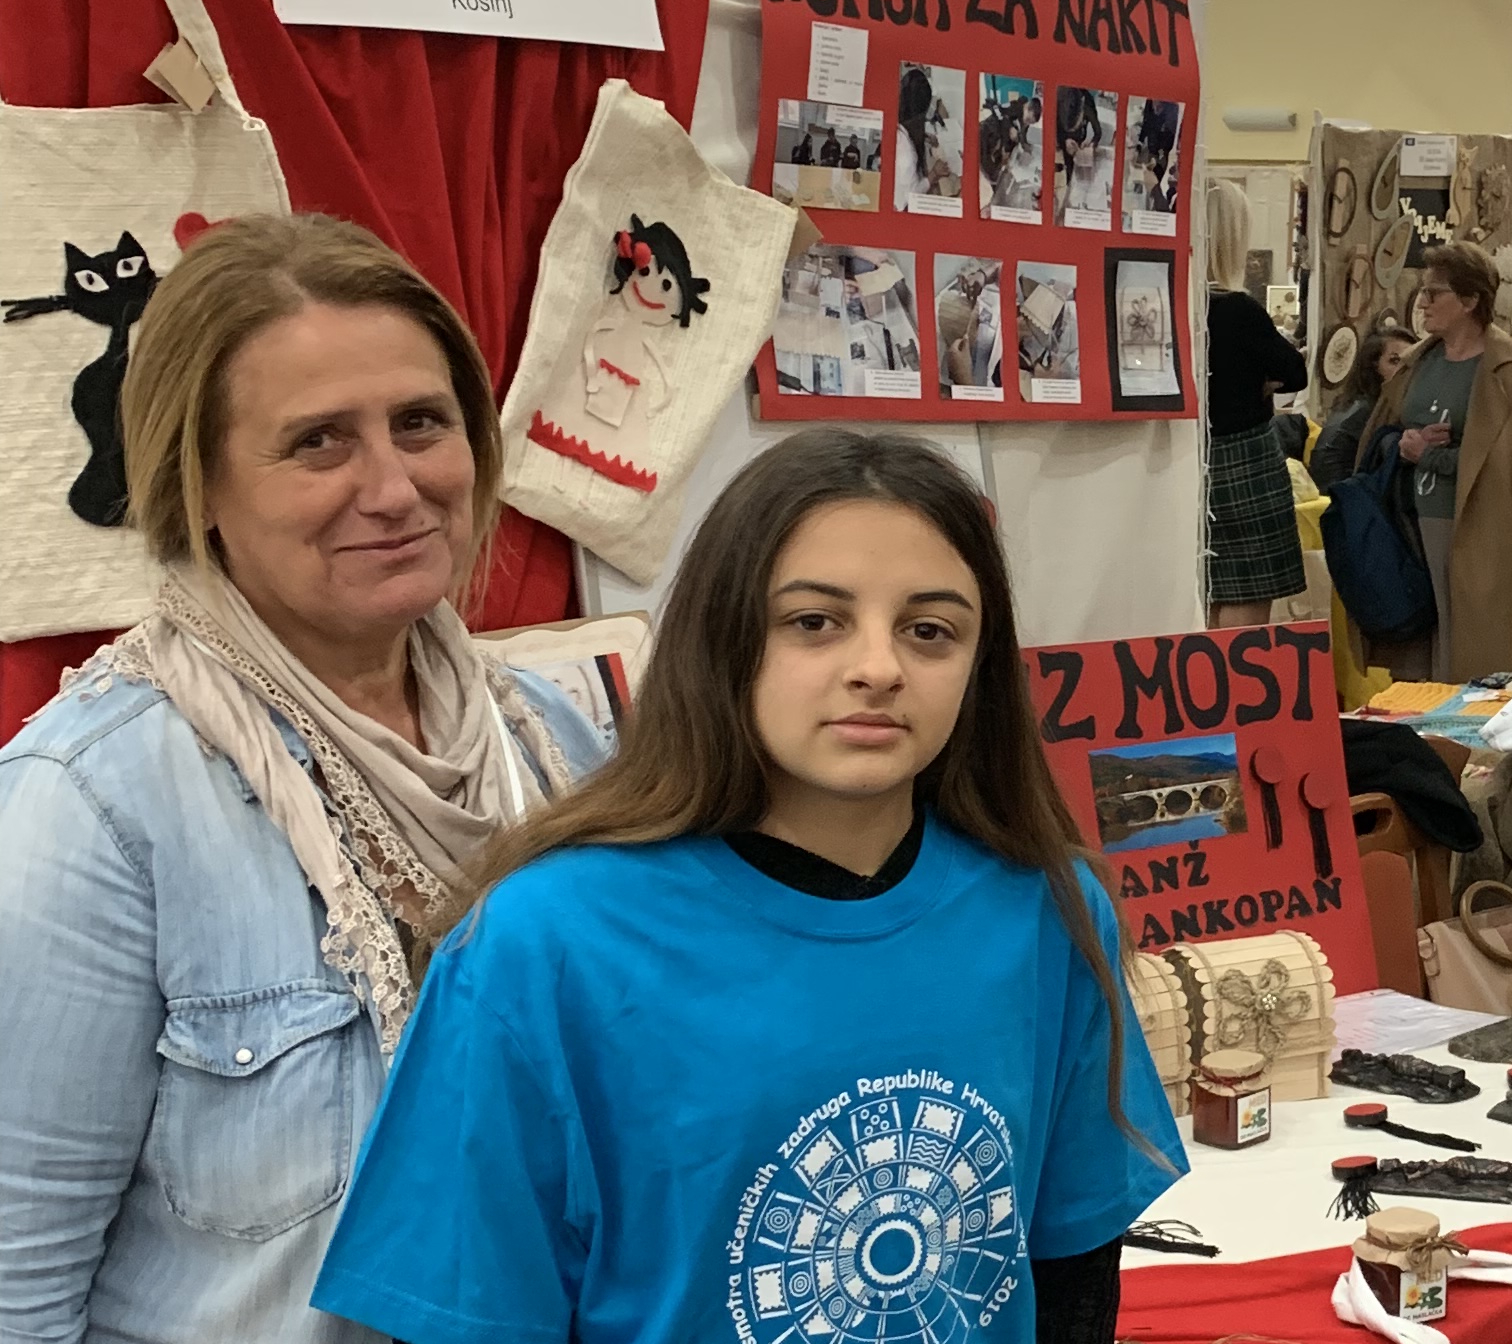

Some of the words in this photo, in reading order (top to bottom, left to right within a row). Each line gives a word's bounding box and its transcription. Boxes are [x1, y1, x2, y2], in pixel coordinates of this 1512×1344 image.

[1037, 650, 1096, 744] Z
[1113, 624, 1330, 740] MOST
[1119, 839, 1210, 899] ANŽ
[1138, 877, 1343, 948] ANKOPAN
[725, 1163, 780, 1265] učeničkih
[777, 1091, 852, 1159] zadruga
[856, 1068, 955, 1098] Republike
